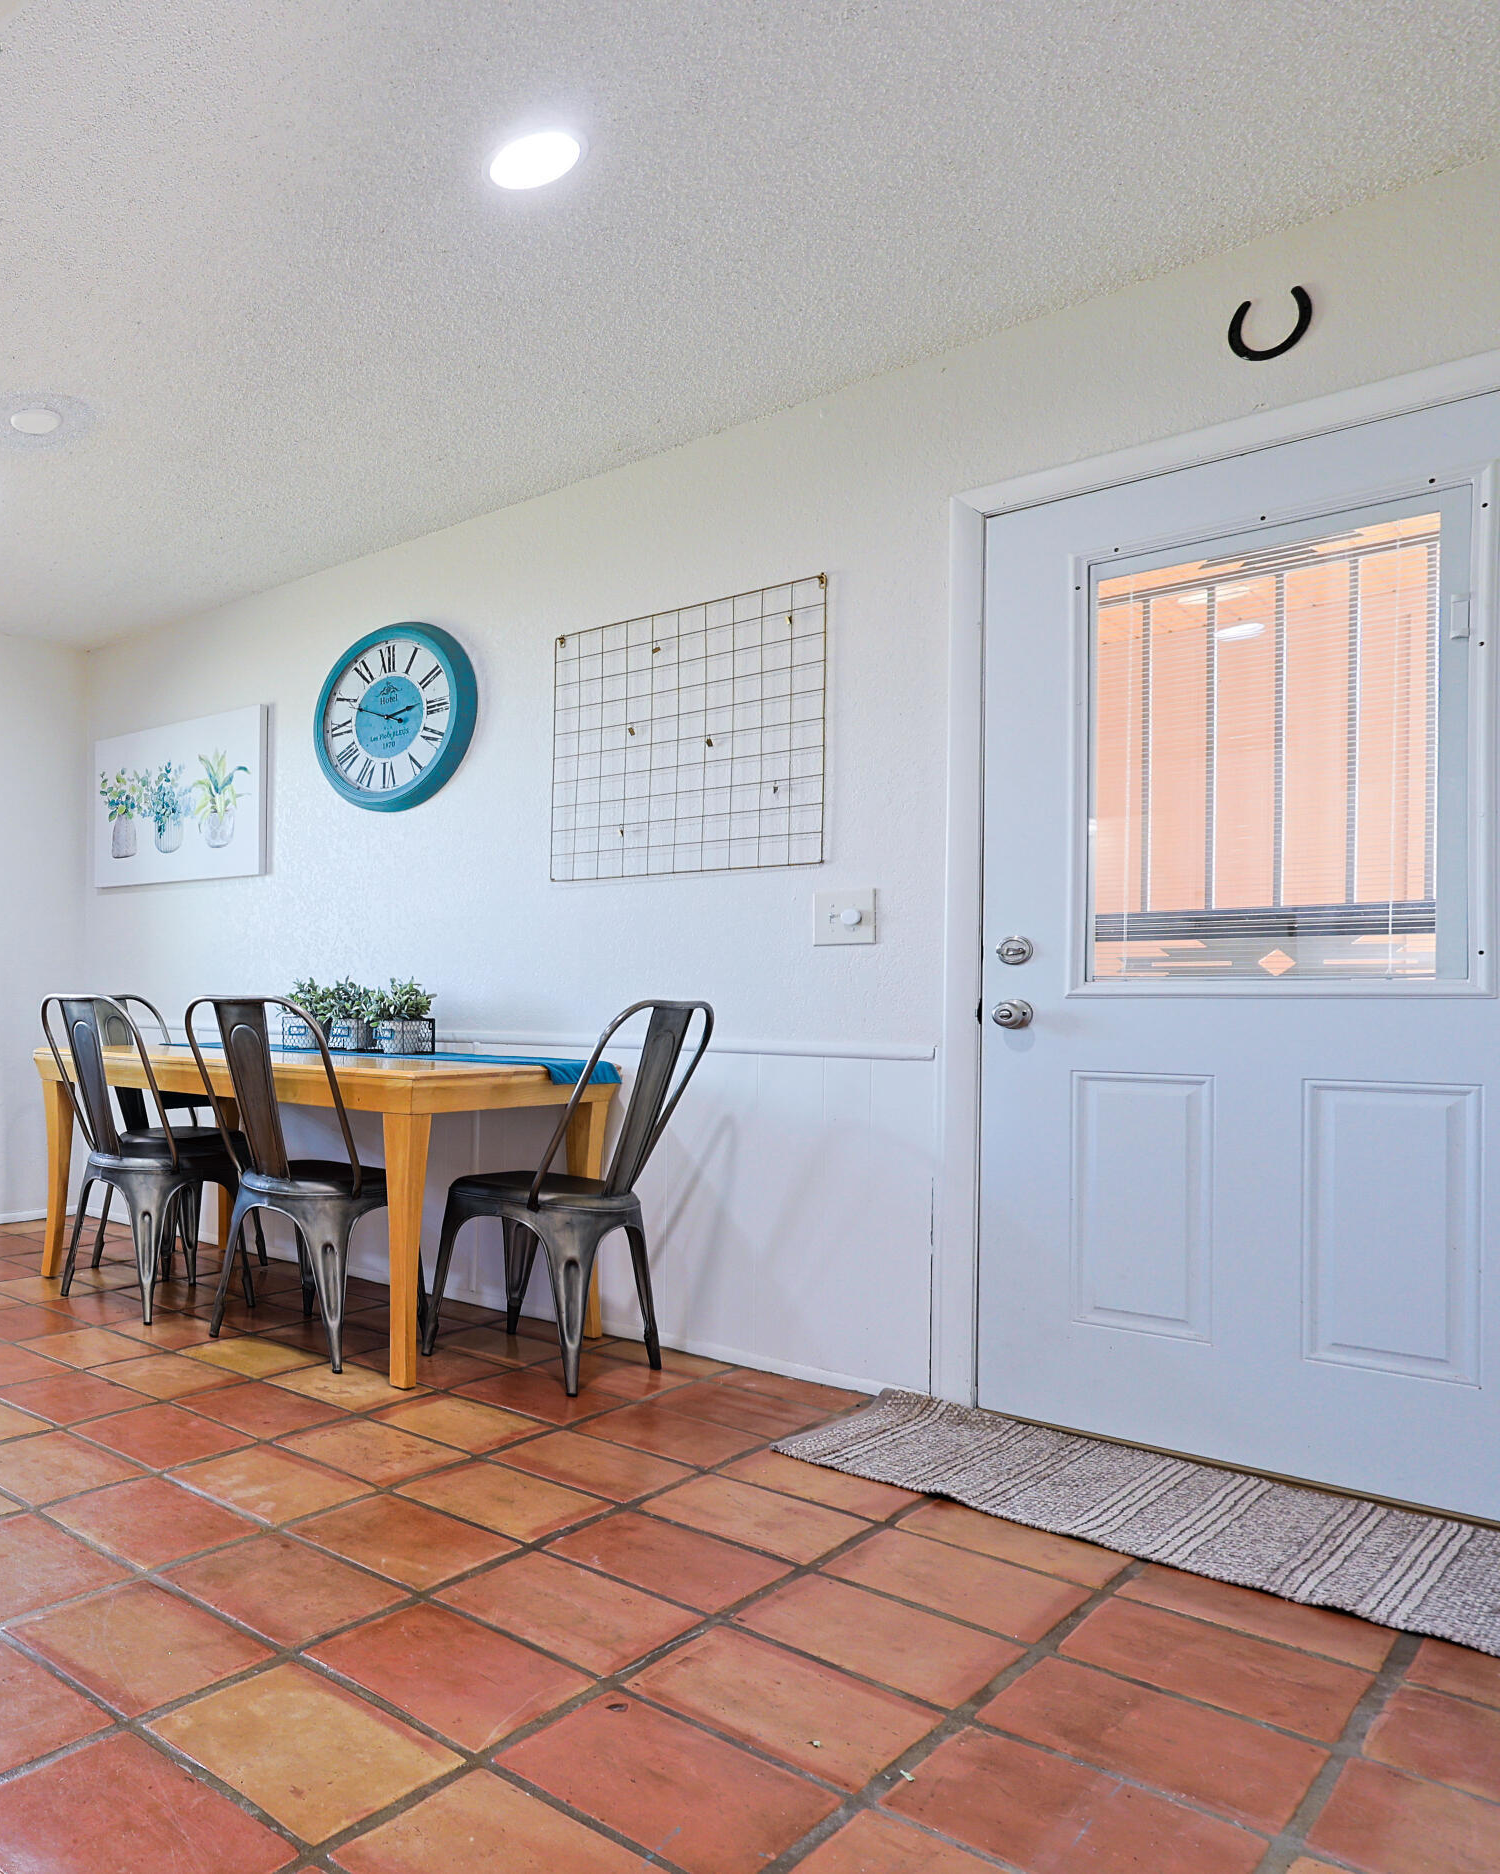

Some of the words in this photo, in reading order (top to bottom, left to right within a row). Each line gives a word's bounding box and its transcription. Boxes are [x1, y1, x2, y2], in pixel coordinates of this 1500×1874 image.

[351, 657, 376, 690] XI
[378, 644, 397, 677] XII
[402, 646, 421, 676] I
[417, 661, 444, 690] II
[380, 694, 398, 705] Hotel
[425, 695, 450, 719] III
[331, 717, 353, 738] IX
[420, 726, 445, 750] IV
[335, 741, 361, 774] VIII
[356, 757, 377, 789] VII
[380, 761, 399, 790] VI
